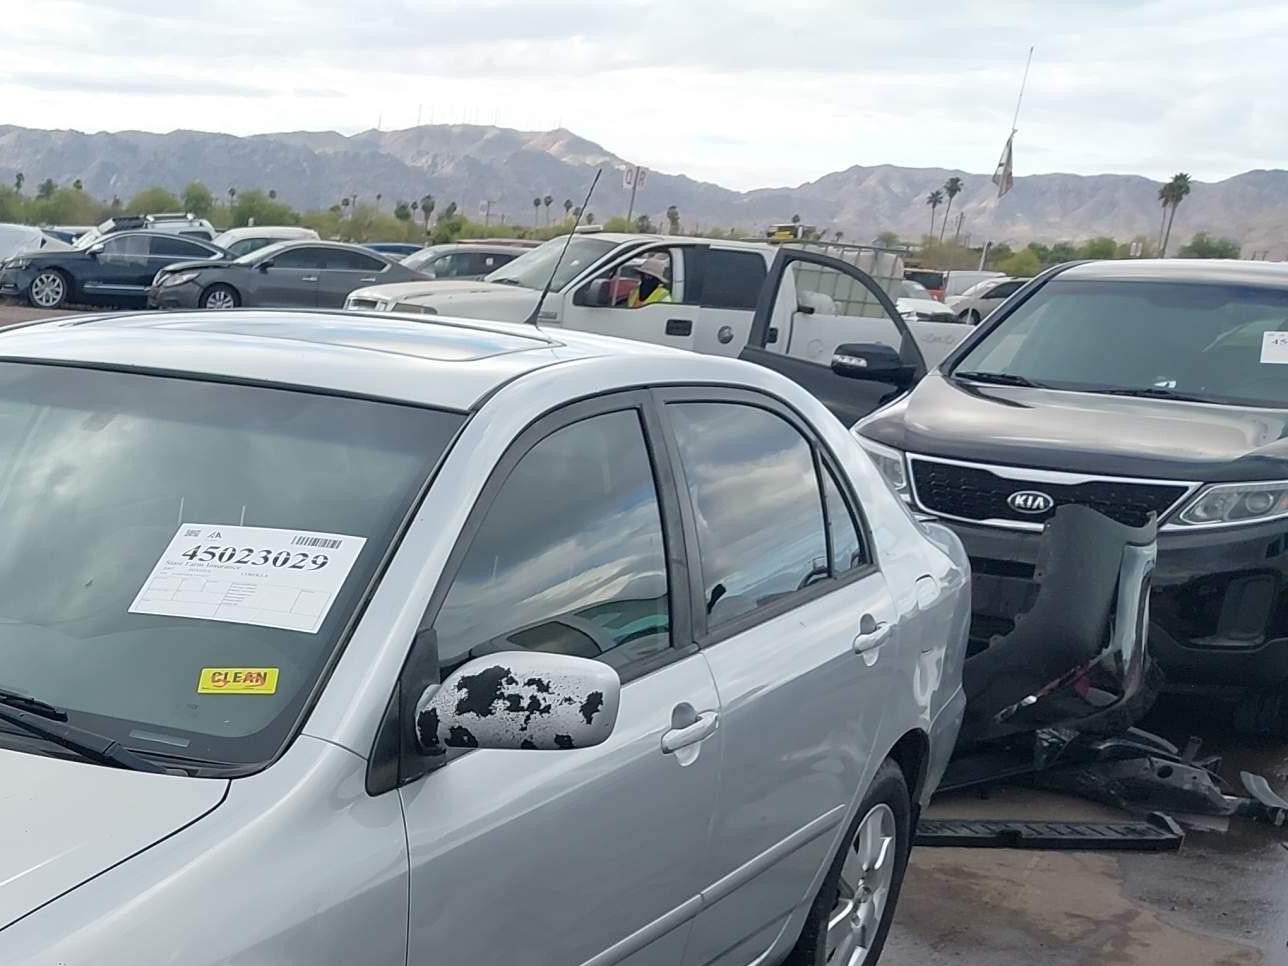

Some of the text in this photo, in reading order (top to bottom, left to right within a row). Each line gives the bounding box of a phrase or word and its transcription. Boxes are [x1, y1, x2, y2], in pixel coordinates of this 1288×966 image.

[1014, 494, 1045, 510] KIA
[182, 545, 329, 571] 45023029
[211, 672, 268, 683] CLEAN
